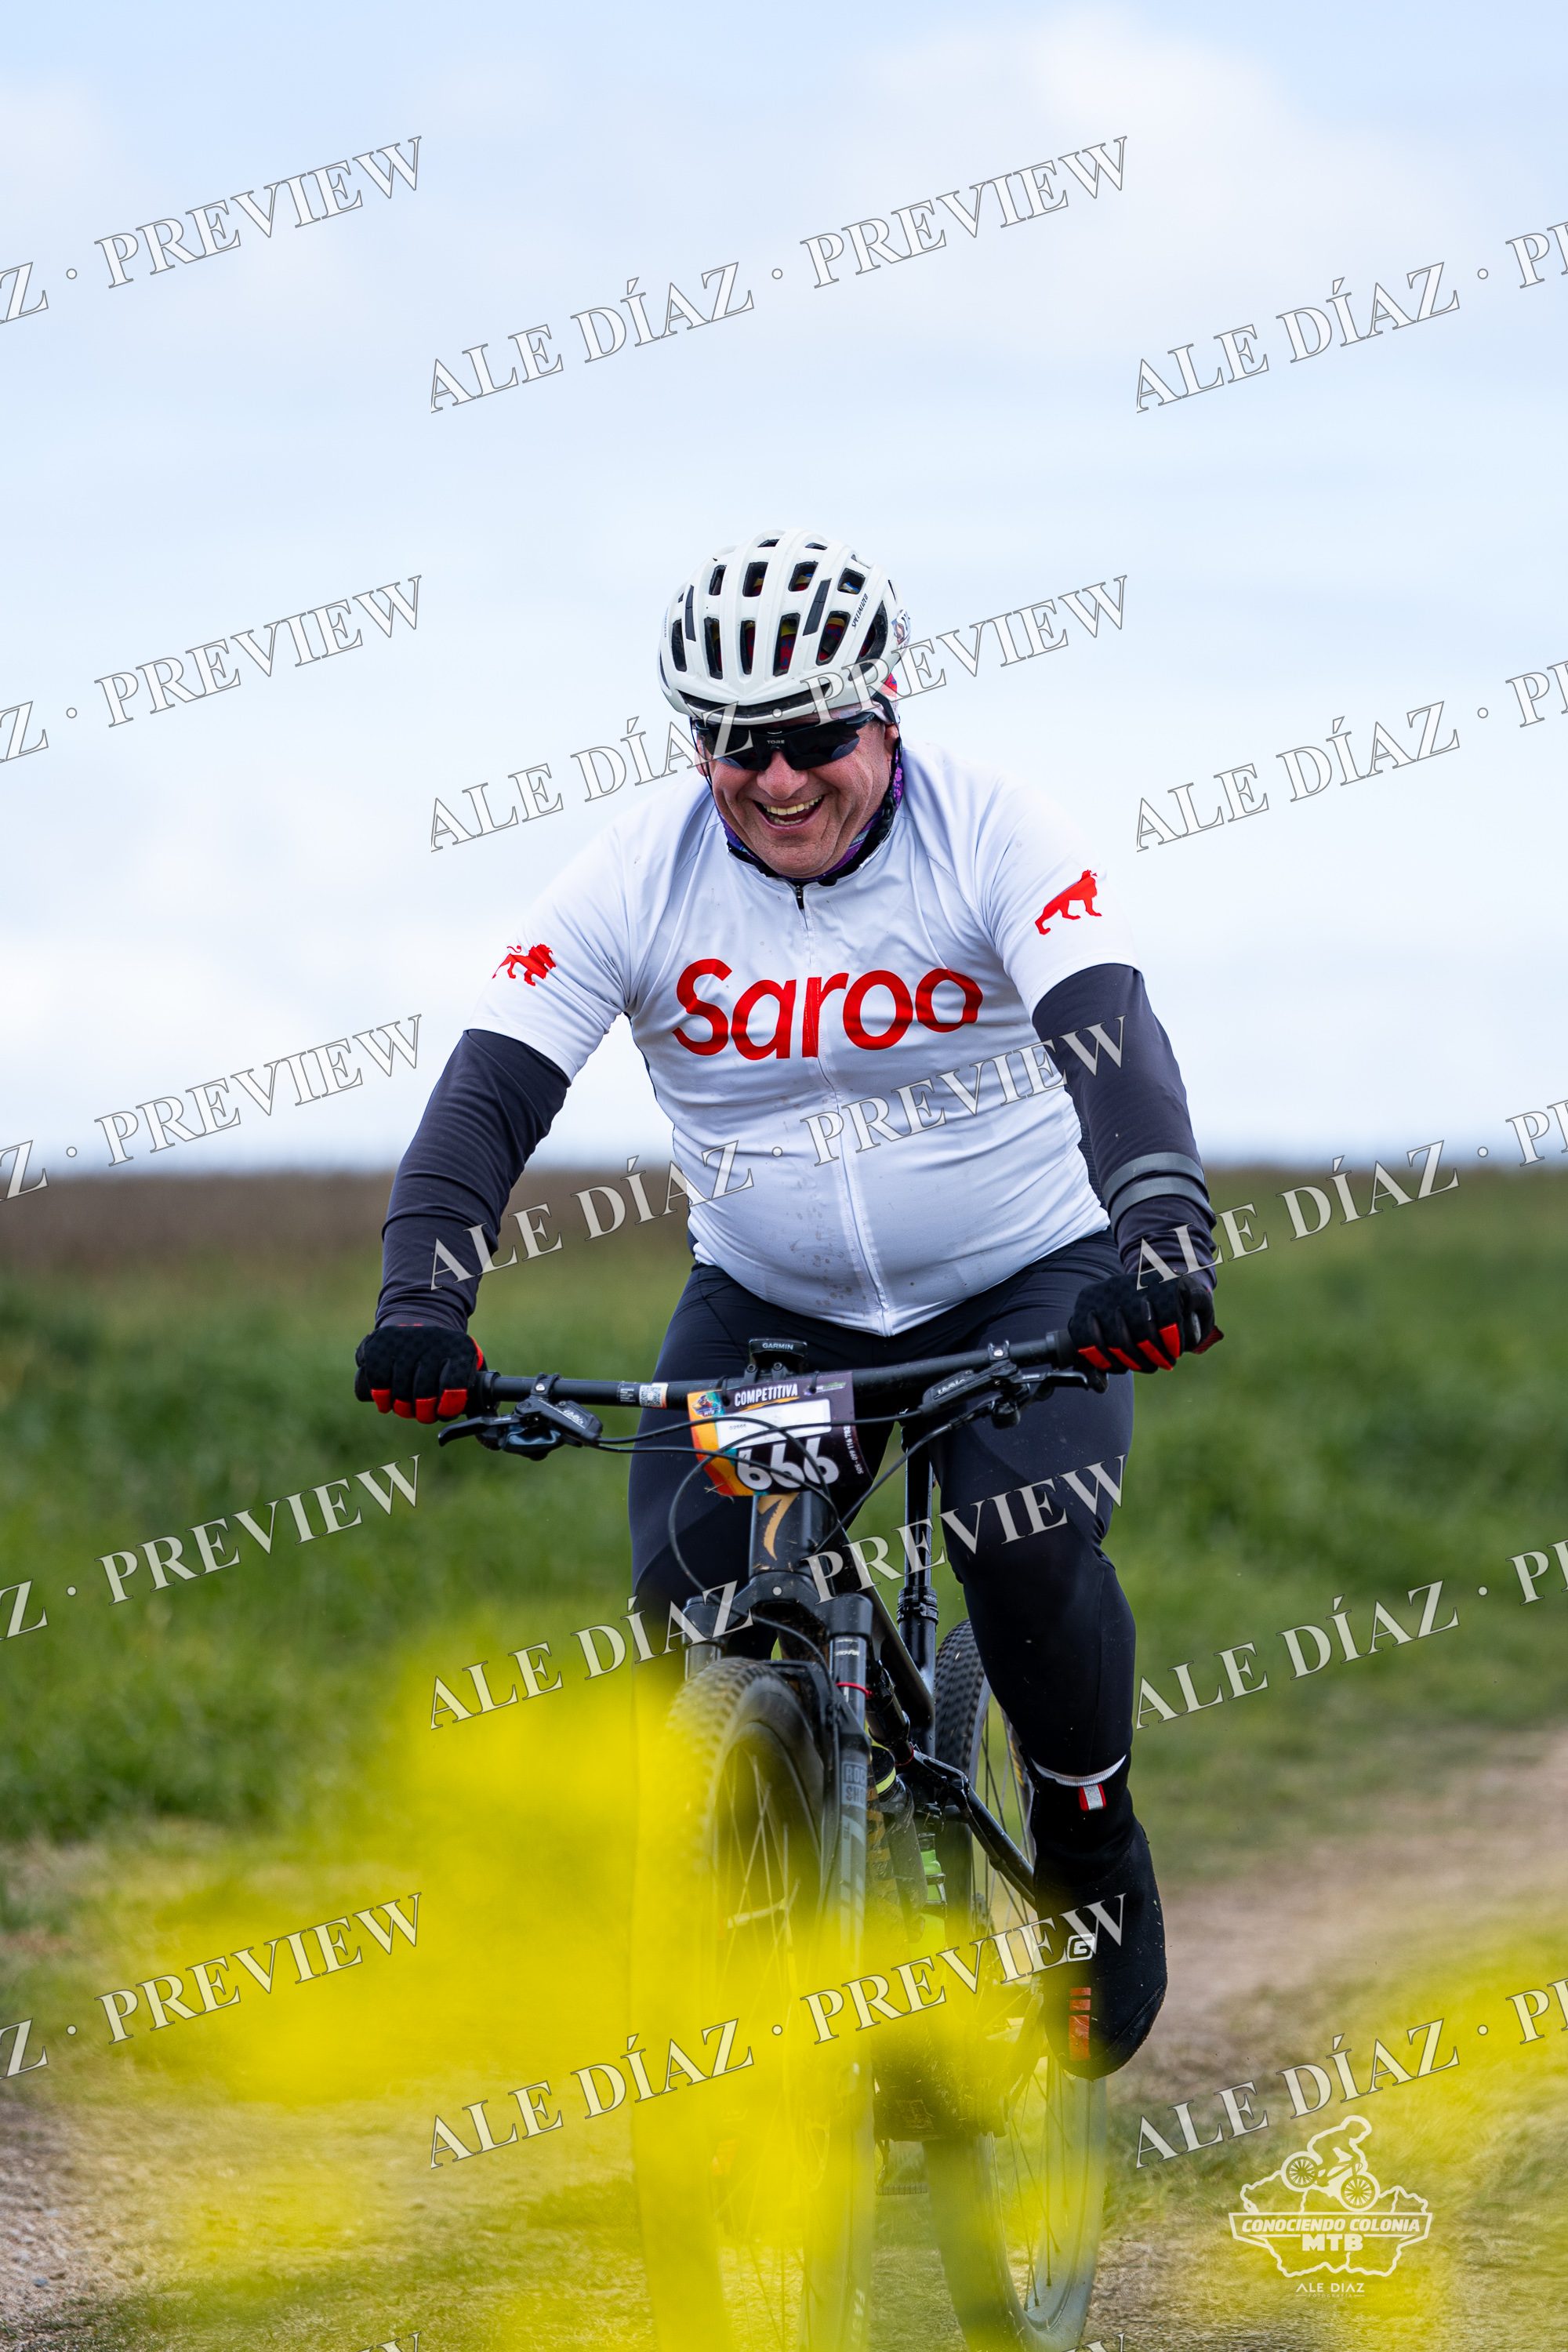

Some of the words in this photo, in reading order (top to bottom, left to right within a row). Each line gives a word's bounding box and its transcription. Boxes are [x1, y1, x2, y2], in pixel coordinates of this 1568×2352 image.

[672, 958, 984, 1061] Saroo
[735, 1383, 798, 1406] COMPETITIVA
[737, 1437, 840, 1490] 666
